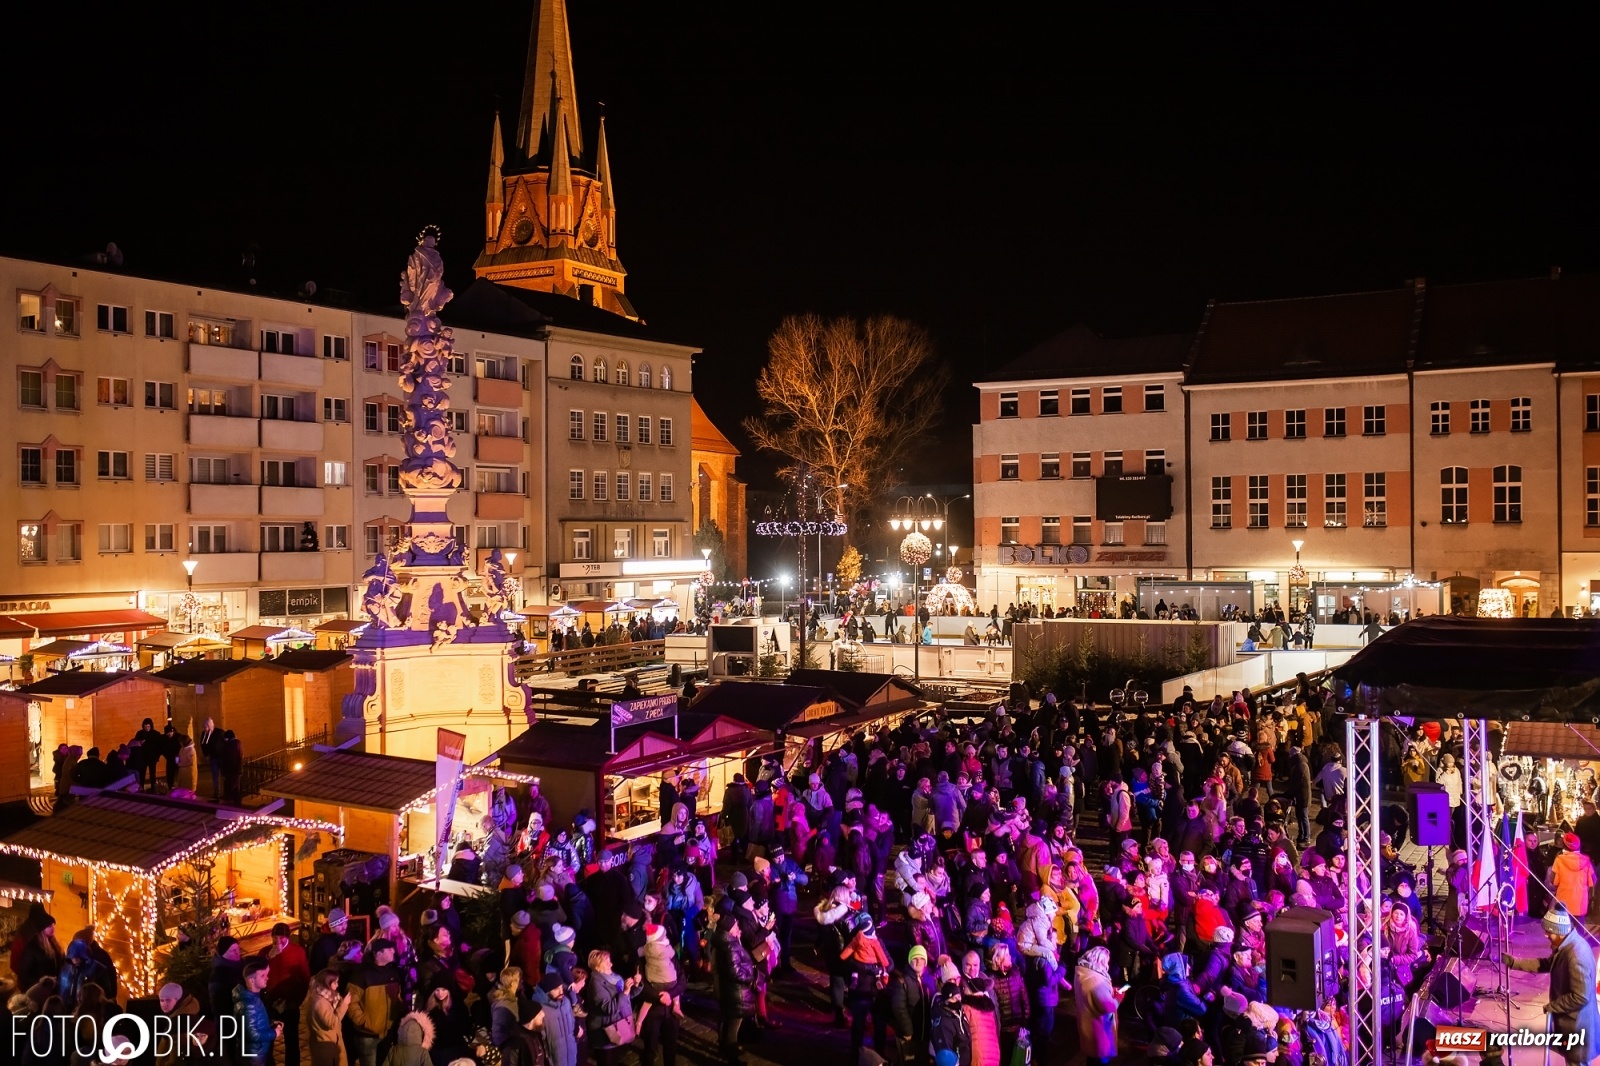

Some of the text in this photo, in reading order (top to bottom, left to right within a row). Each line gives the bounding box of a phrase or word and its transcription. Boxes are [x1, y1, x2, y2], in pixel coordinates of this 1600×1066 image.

[999, 545, 1088, 565] BOLKO
[290, 593, 318, 606] empik
[659, 694, 677, 706] PROSTO
[649, 708, 664, 718] PIECA
